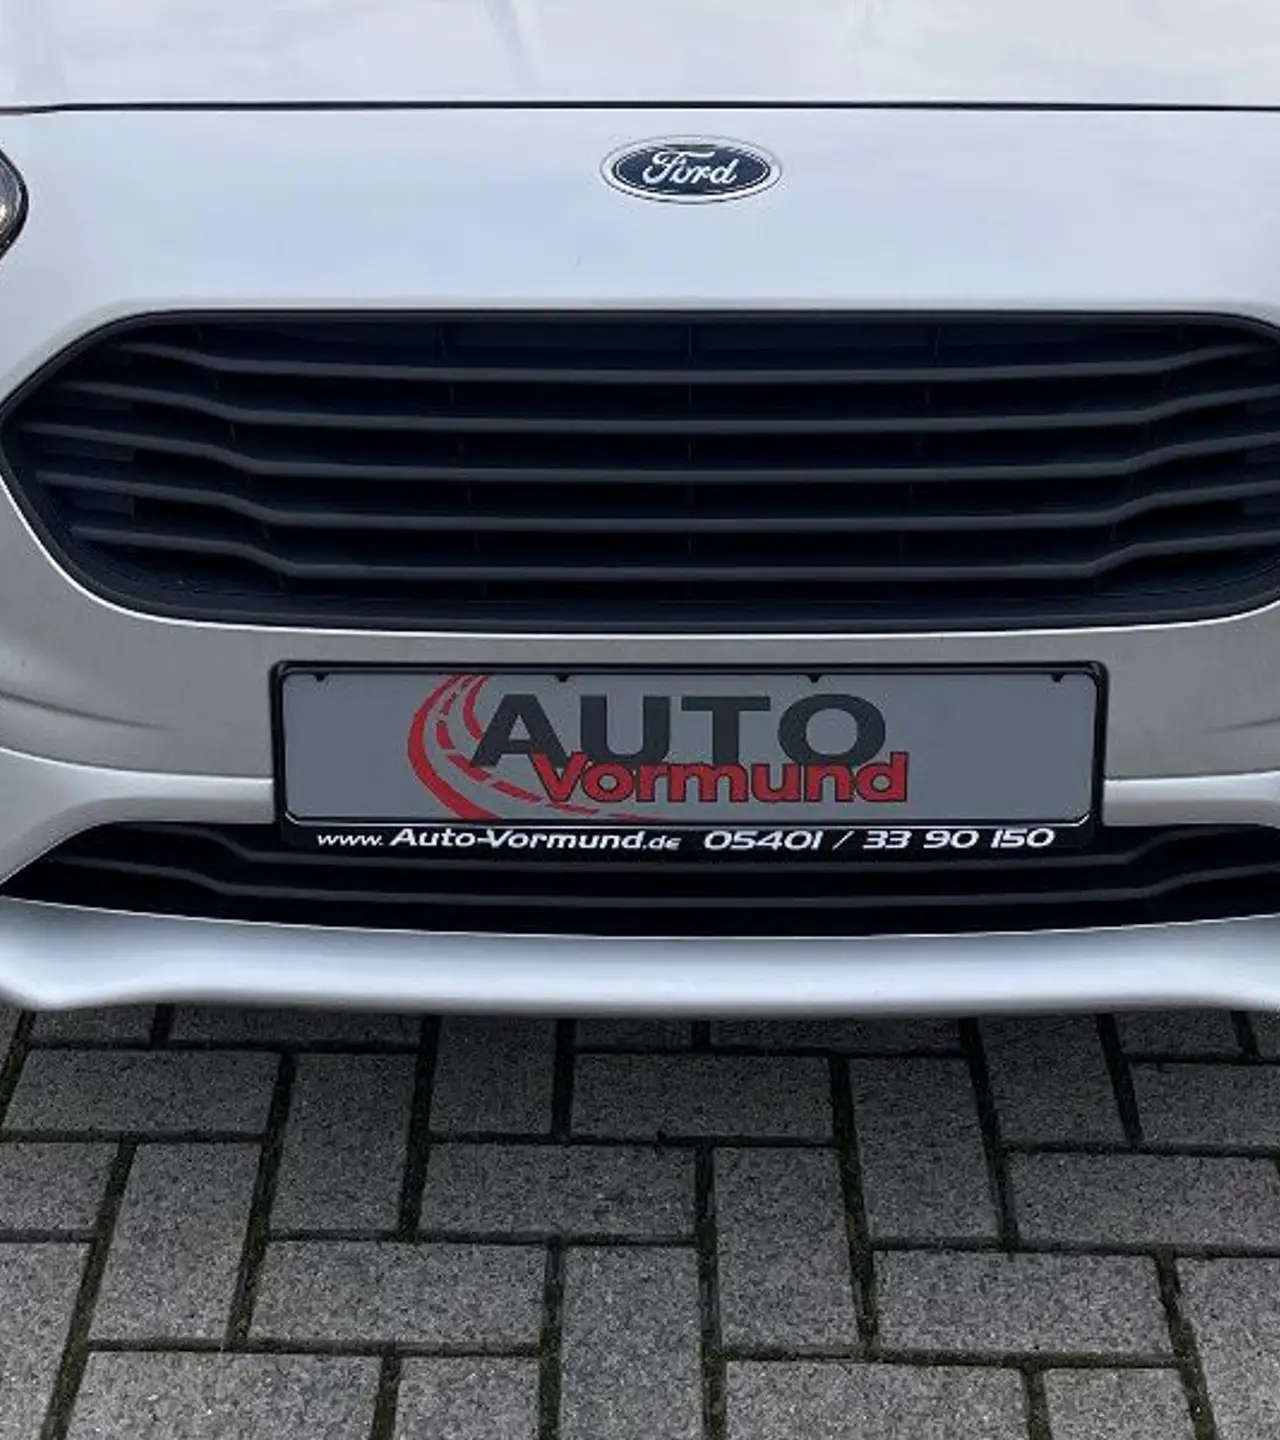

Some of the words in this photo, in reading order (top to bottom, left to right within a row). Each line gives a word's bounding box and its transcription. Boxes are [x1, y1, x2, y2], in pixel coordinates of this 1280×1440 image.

[642, 151, 739, 184] Ford
[470, 693, 886, 767] AUTO
[532, 751, 909, 803] Vormund
[317, 827, 682, 851] www.Auto-Vormund.de
[704, 830, 823, 851] 05401
[862, 830, 912, 849] 33
[923, 829, 980, 848] 90
[990, 828, 1055, 848] 150
